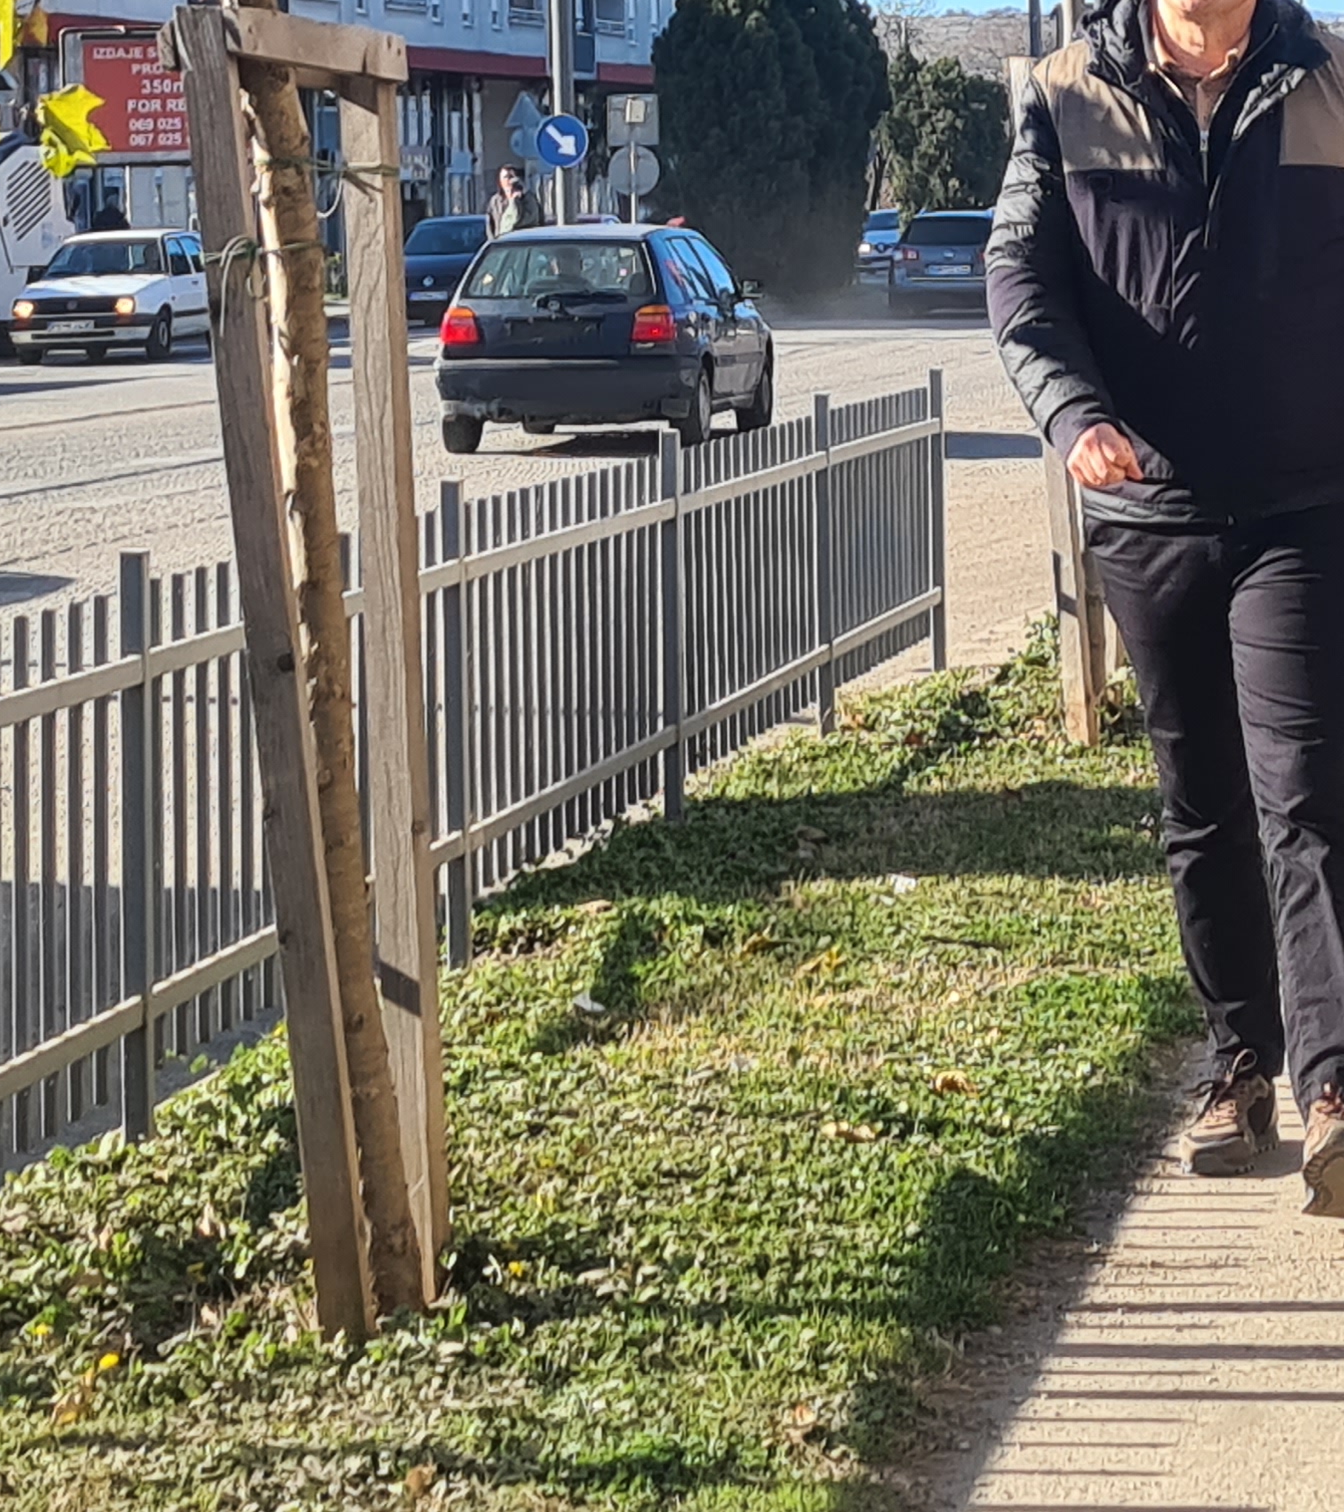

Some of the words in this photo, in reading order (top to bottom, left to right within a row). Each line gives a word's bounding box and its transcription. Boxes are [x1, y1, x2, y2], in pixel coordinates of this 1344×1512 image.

[93, 47, 143, 59] IZDAJE
[147, 47, 158, 59] S
[131, 63, 164, 75] PRO
[127, 99, 161, 113] FOR
[166, 99, 186, 112] RE
